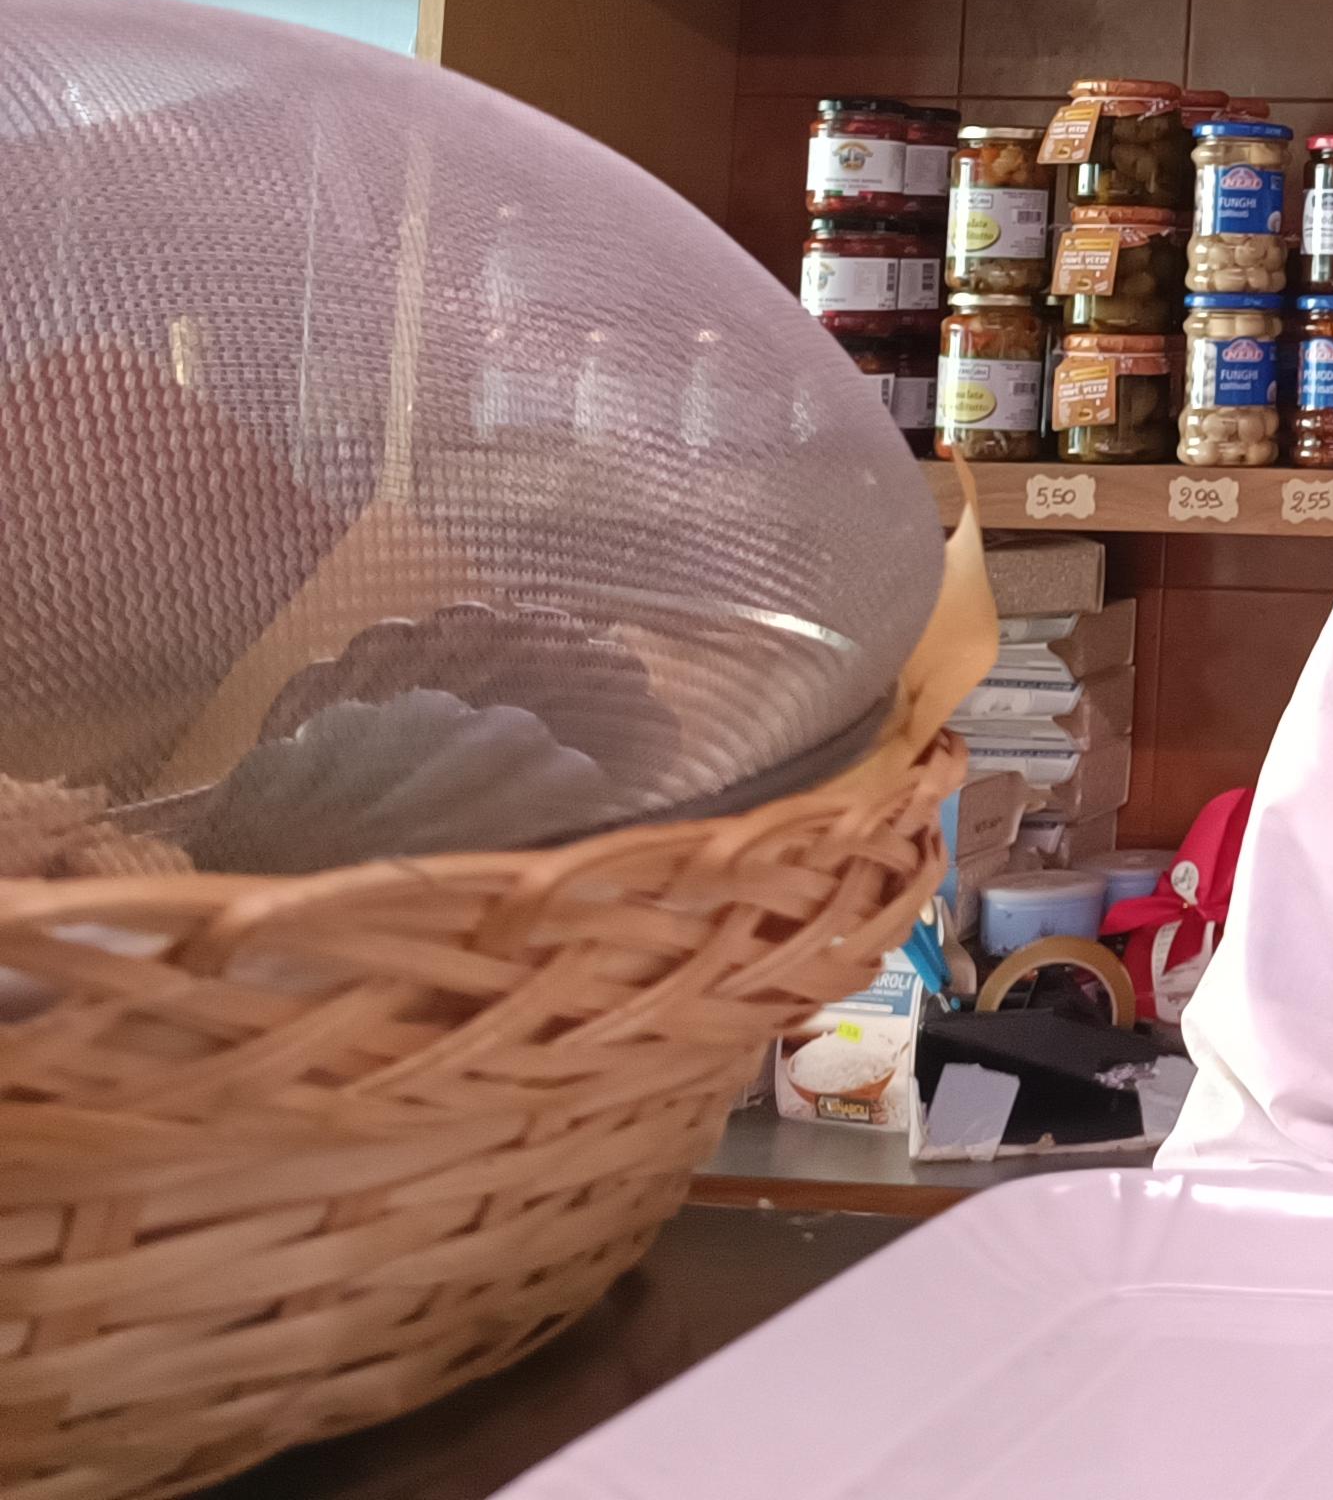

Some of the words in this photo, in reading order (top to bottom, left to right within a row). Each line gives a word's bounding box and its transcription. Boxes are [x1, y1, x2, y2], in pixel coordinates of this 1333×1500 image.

[1220, 197, 1257, 208] FUNGHI
[1220, 369, 1258, 380] FUNGHI
[1036, 488, 1076, 510] 5,50
